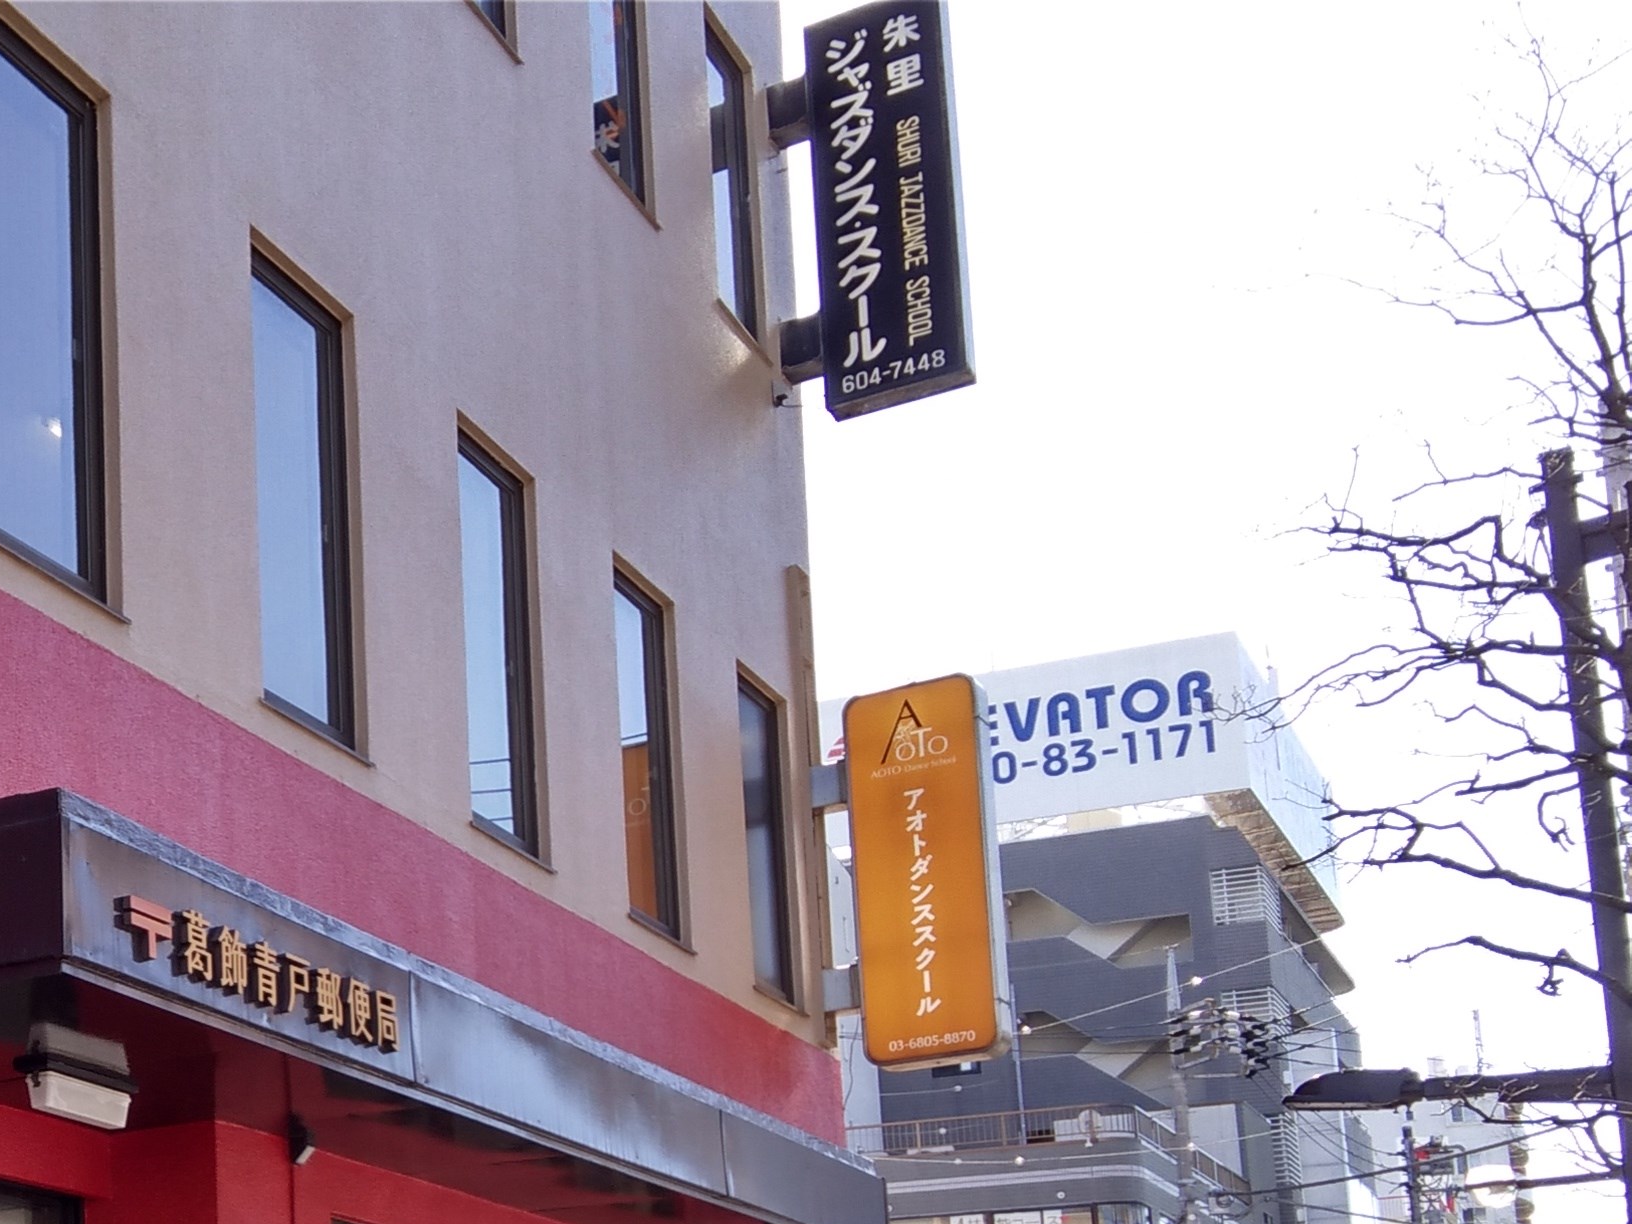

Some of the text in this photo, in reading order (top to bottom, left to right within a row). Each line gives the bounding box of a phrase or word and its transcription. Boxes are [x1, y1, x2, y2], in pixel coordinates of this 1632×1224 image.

[883, 14, 925, 97] 朱里
[896, 115, 933, 347] SHURI JAZZDANCE SCHOOL
[842, 349, 946, 394] 604-7448
[990, 670, 1214, 746] VATOR
[903, 787, 942, 1017] アオトダンススクール
[888, 1029, 976, 1053] 03-6805-8870
